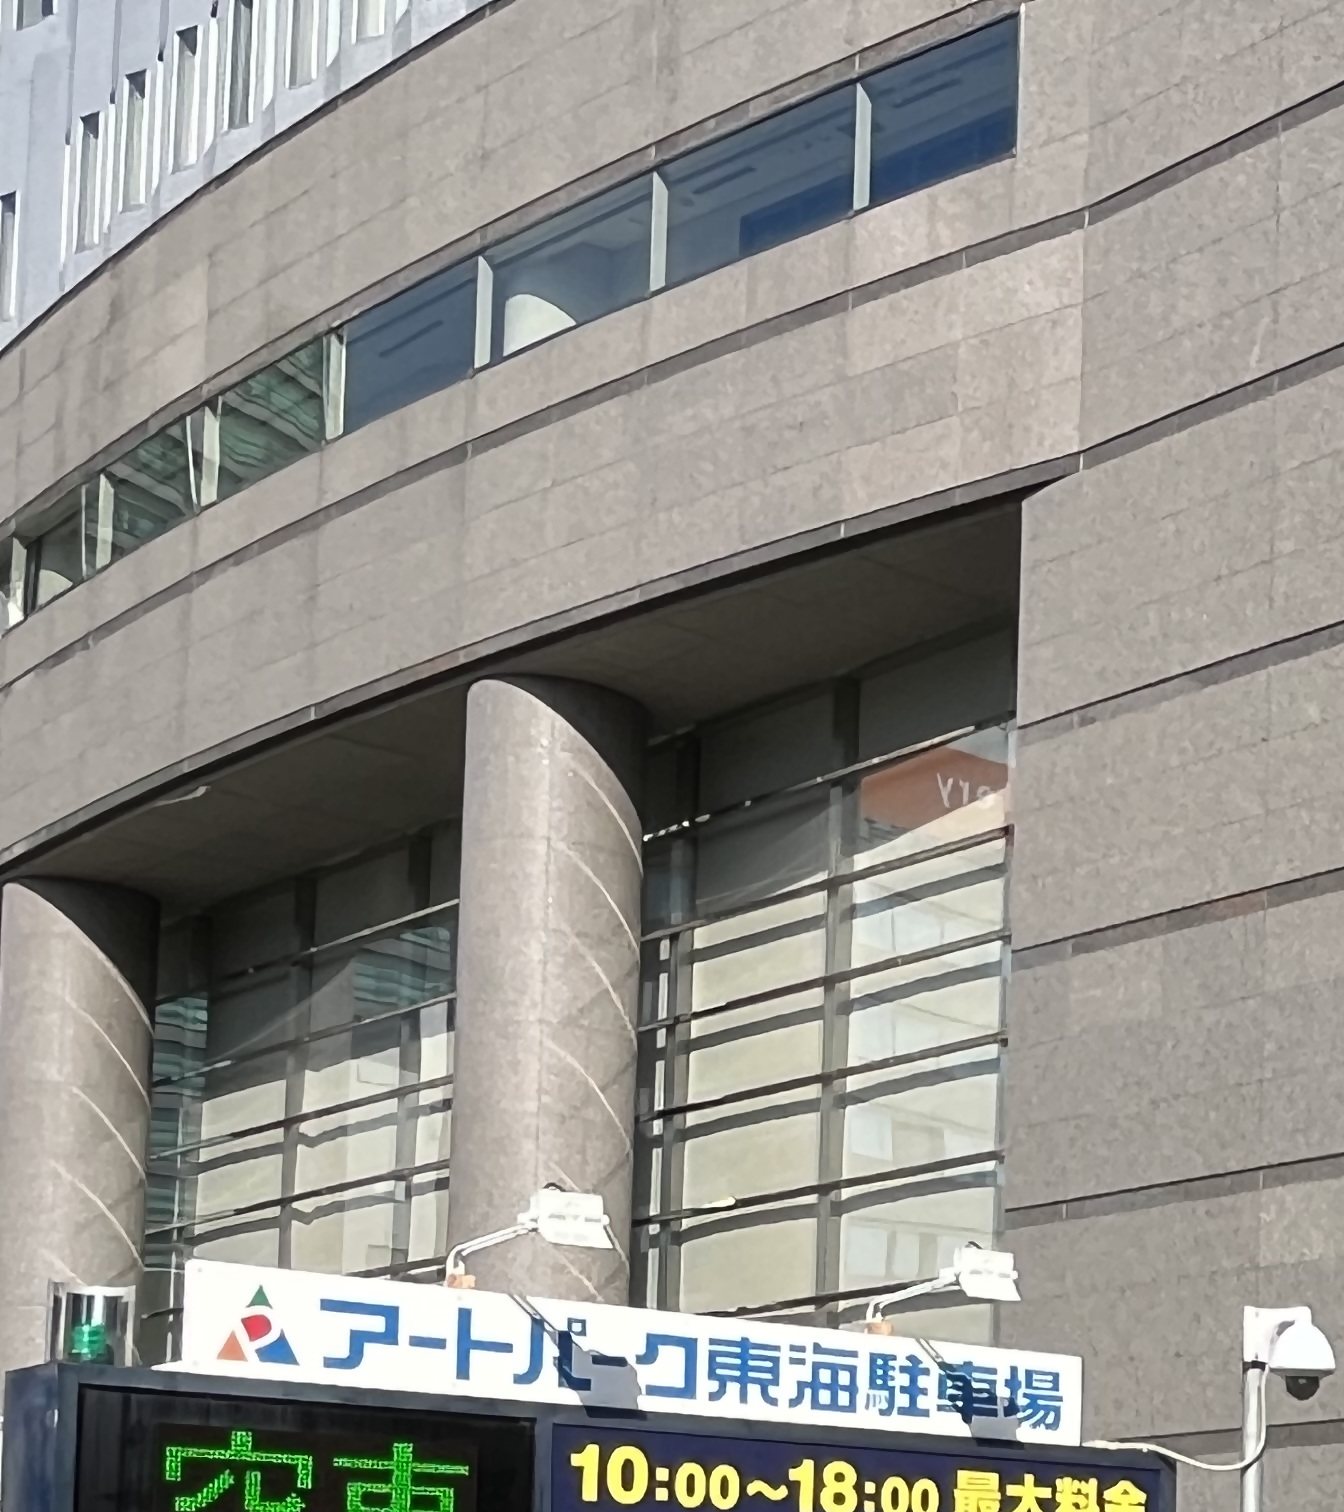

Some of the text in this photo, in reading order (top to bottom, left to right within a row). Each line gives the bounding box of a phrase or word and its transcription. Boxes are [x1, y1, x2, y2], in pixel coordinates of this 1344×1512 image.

[319, 1298, 1064, 1432] アートパーク東海駐車場
